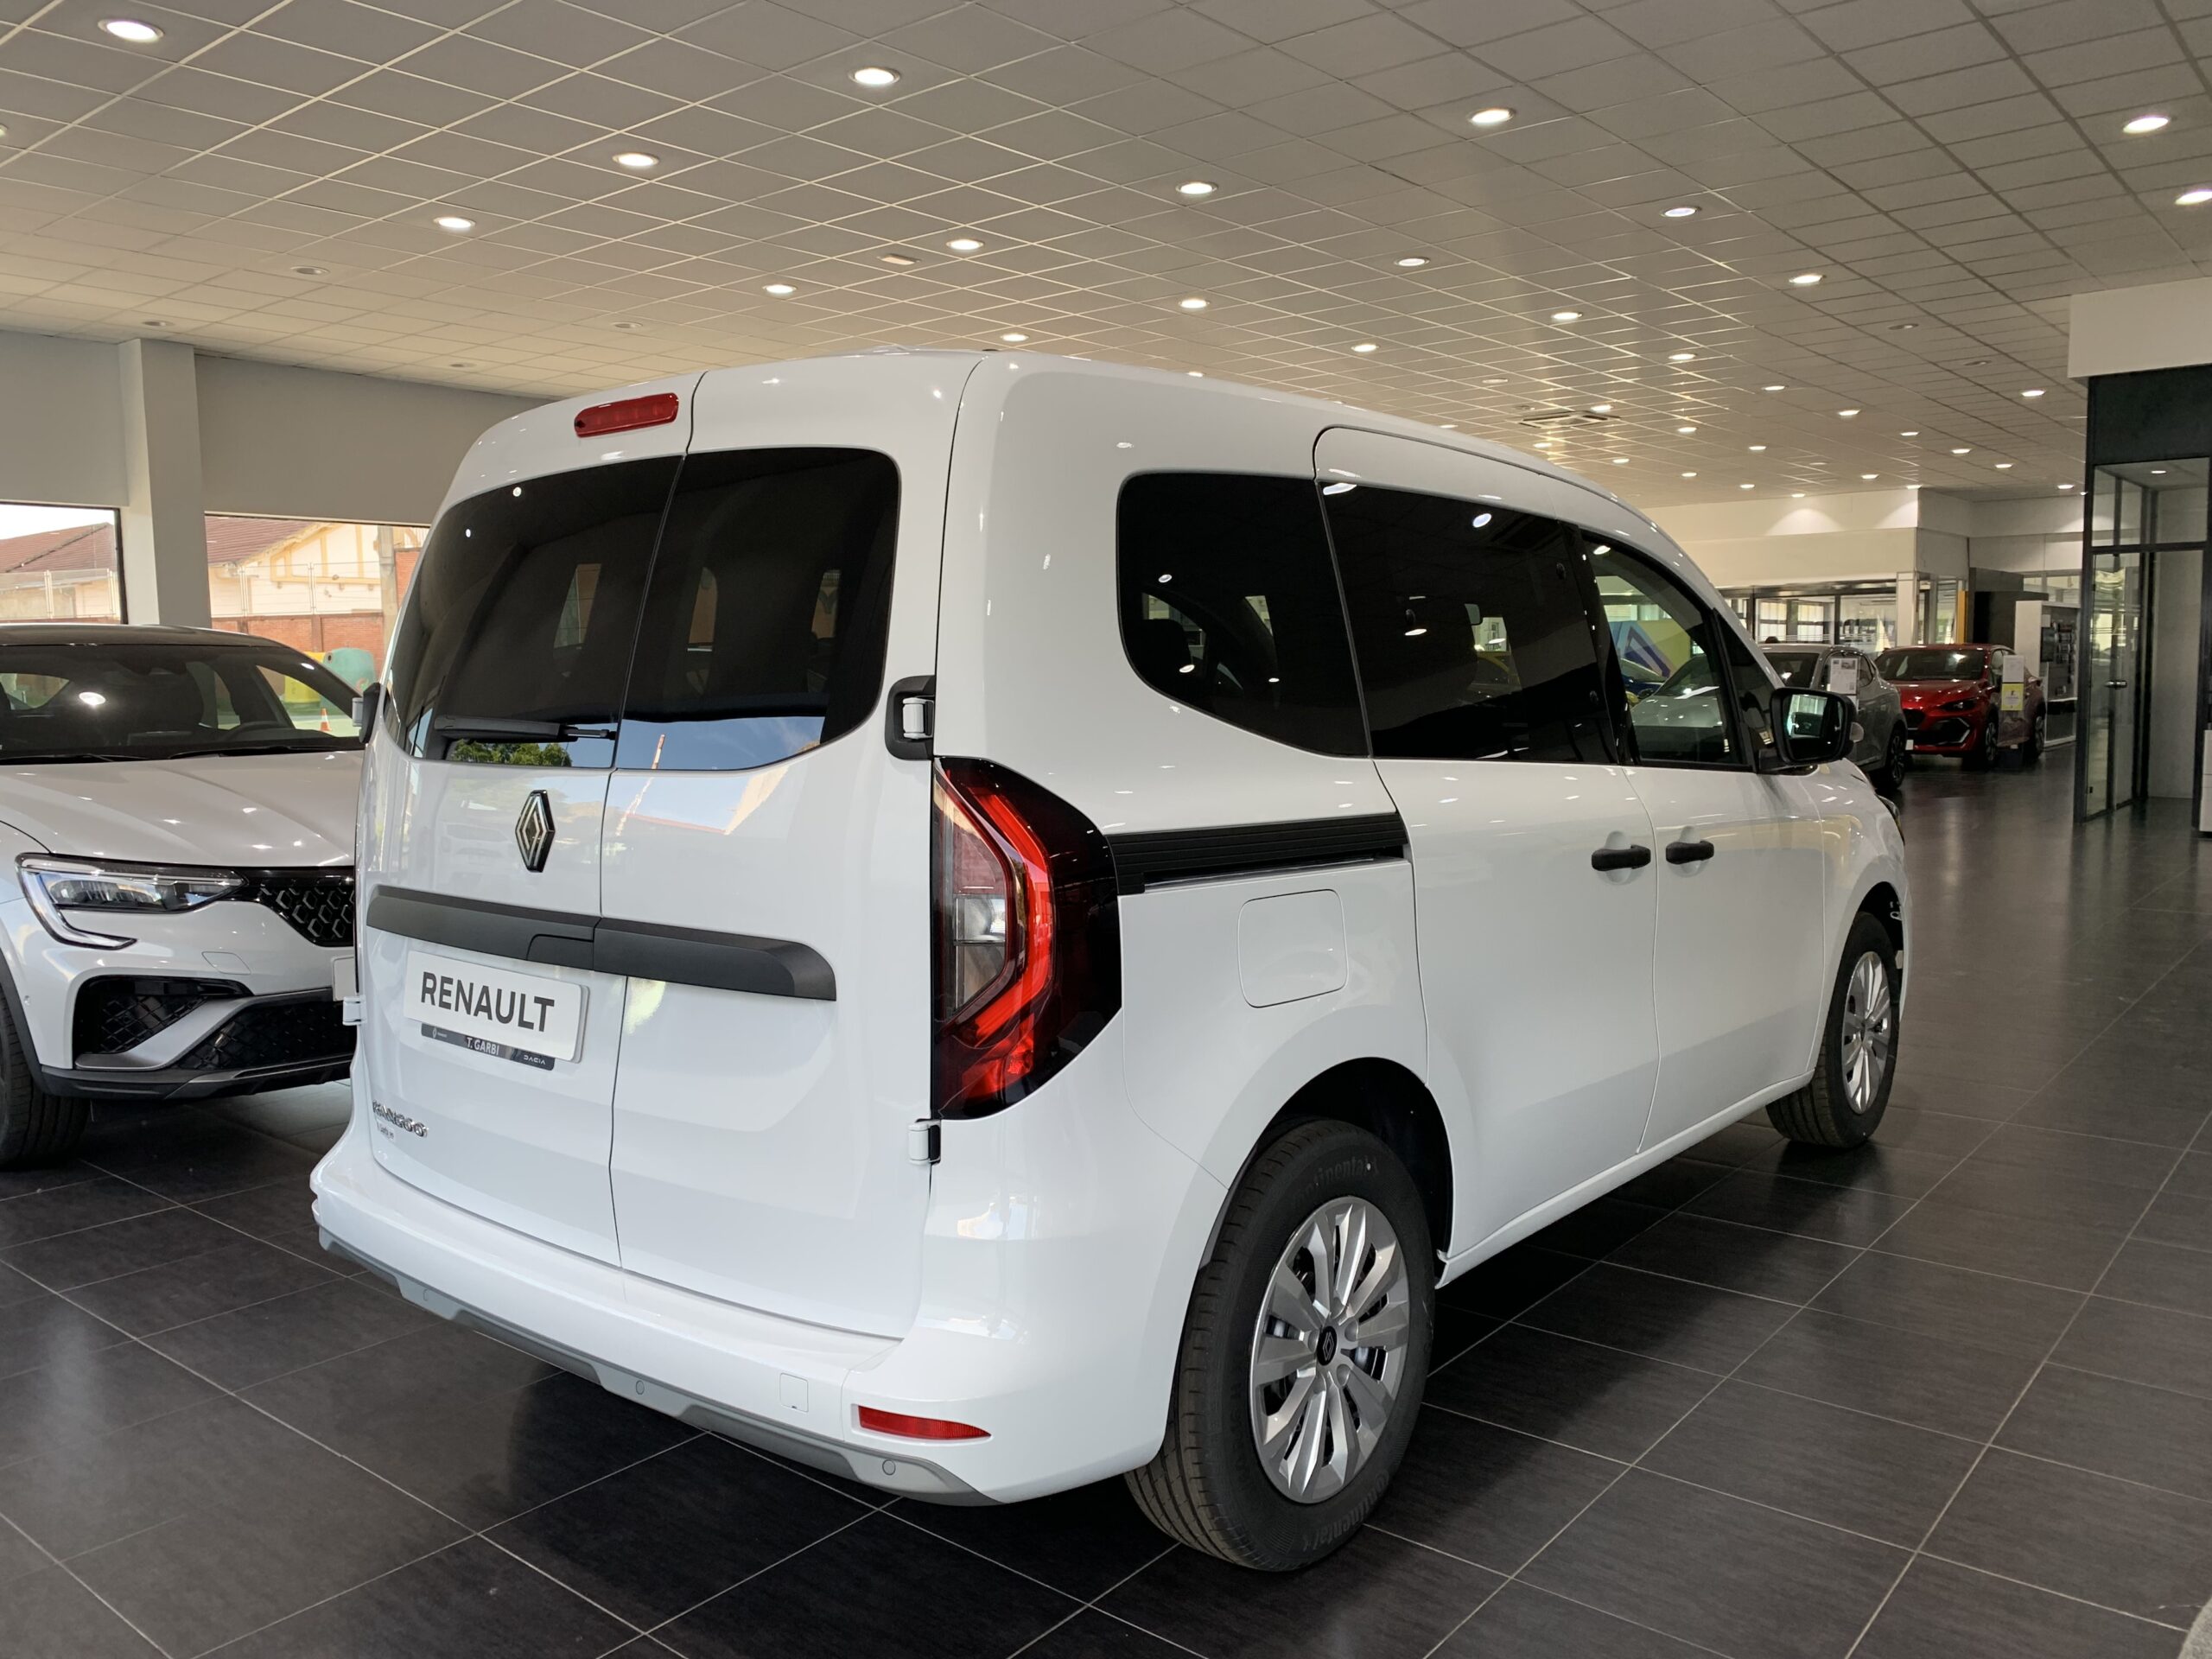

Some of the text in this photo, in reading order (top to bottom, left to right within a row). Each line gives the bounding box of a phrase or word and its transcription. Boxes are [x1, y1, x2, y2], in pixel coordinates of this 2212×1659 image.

[421, 971, 555, 1033] RENAULT
[467, 1037, 499, 1056] T. GARBI
[524, 1054, 546, 1065] DACIA
